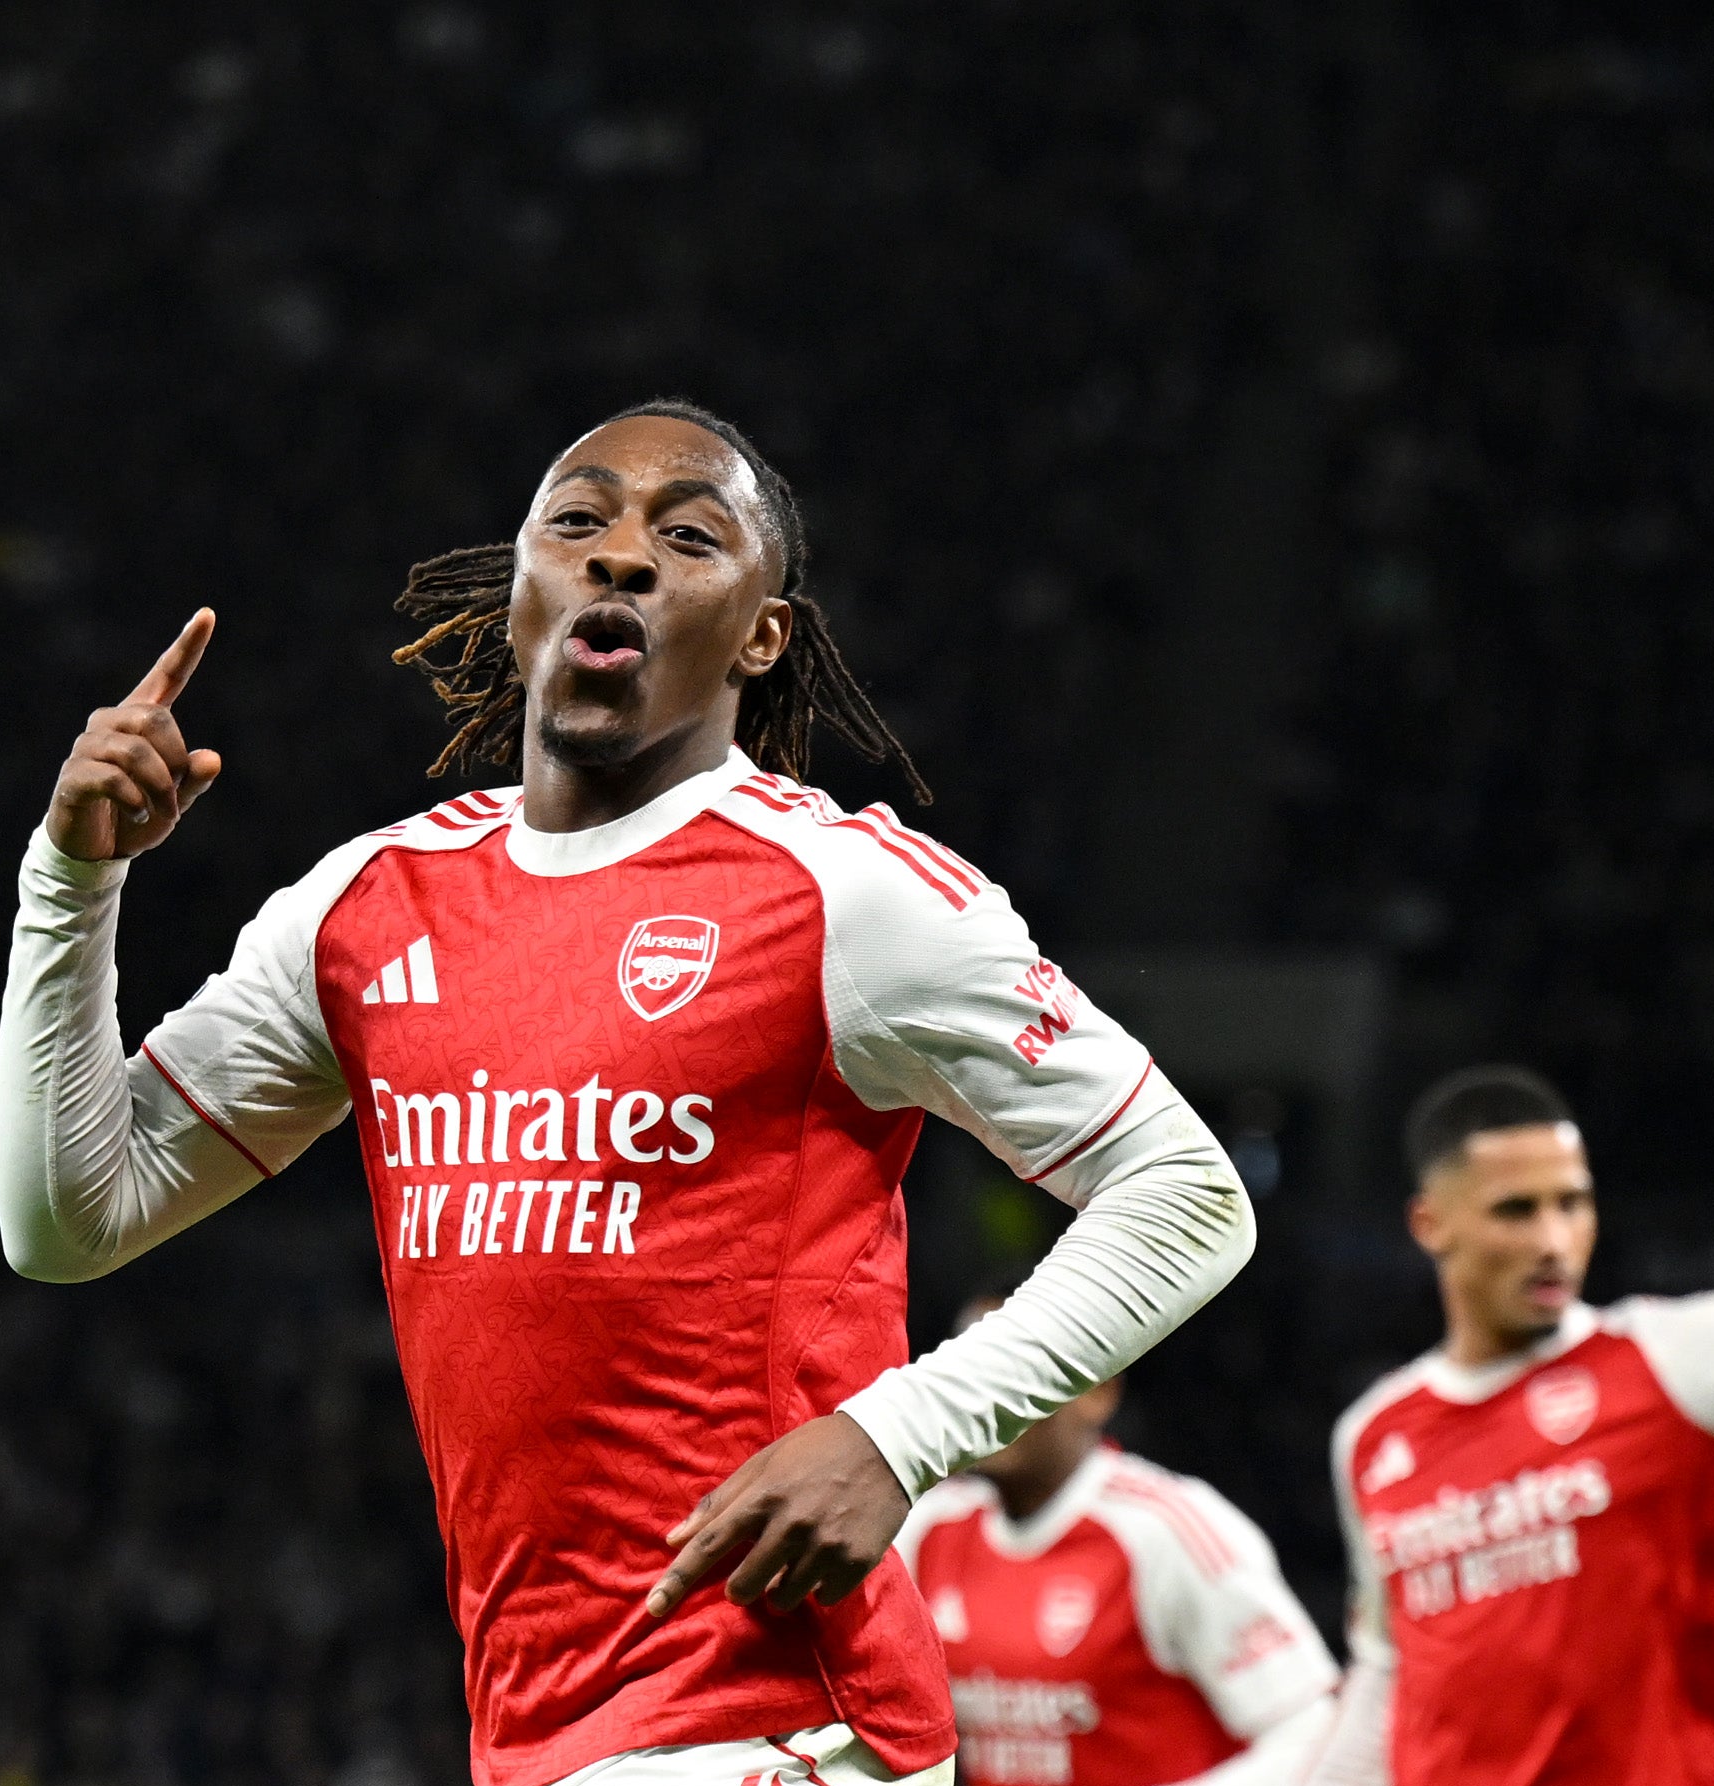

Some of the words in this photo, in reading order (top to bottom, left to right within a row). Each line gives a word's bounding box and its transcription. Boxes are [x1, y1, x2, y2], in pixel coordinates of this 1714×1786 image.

[636, 931, 706, 951] Arsenal
[370, 1068, 715, 1168] Emirates
[398, 1184, 451, 1259] FLY
[459, 1180, 642, 1256] BETTER
